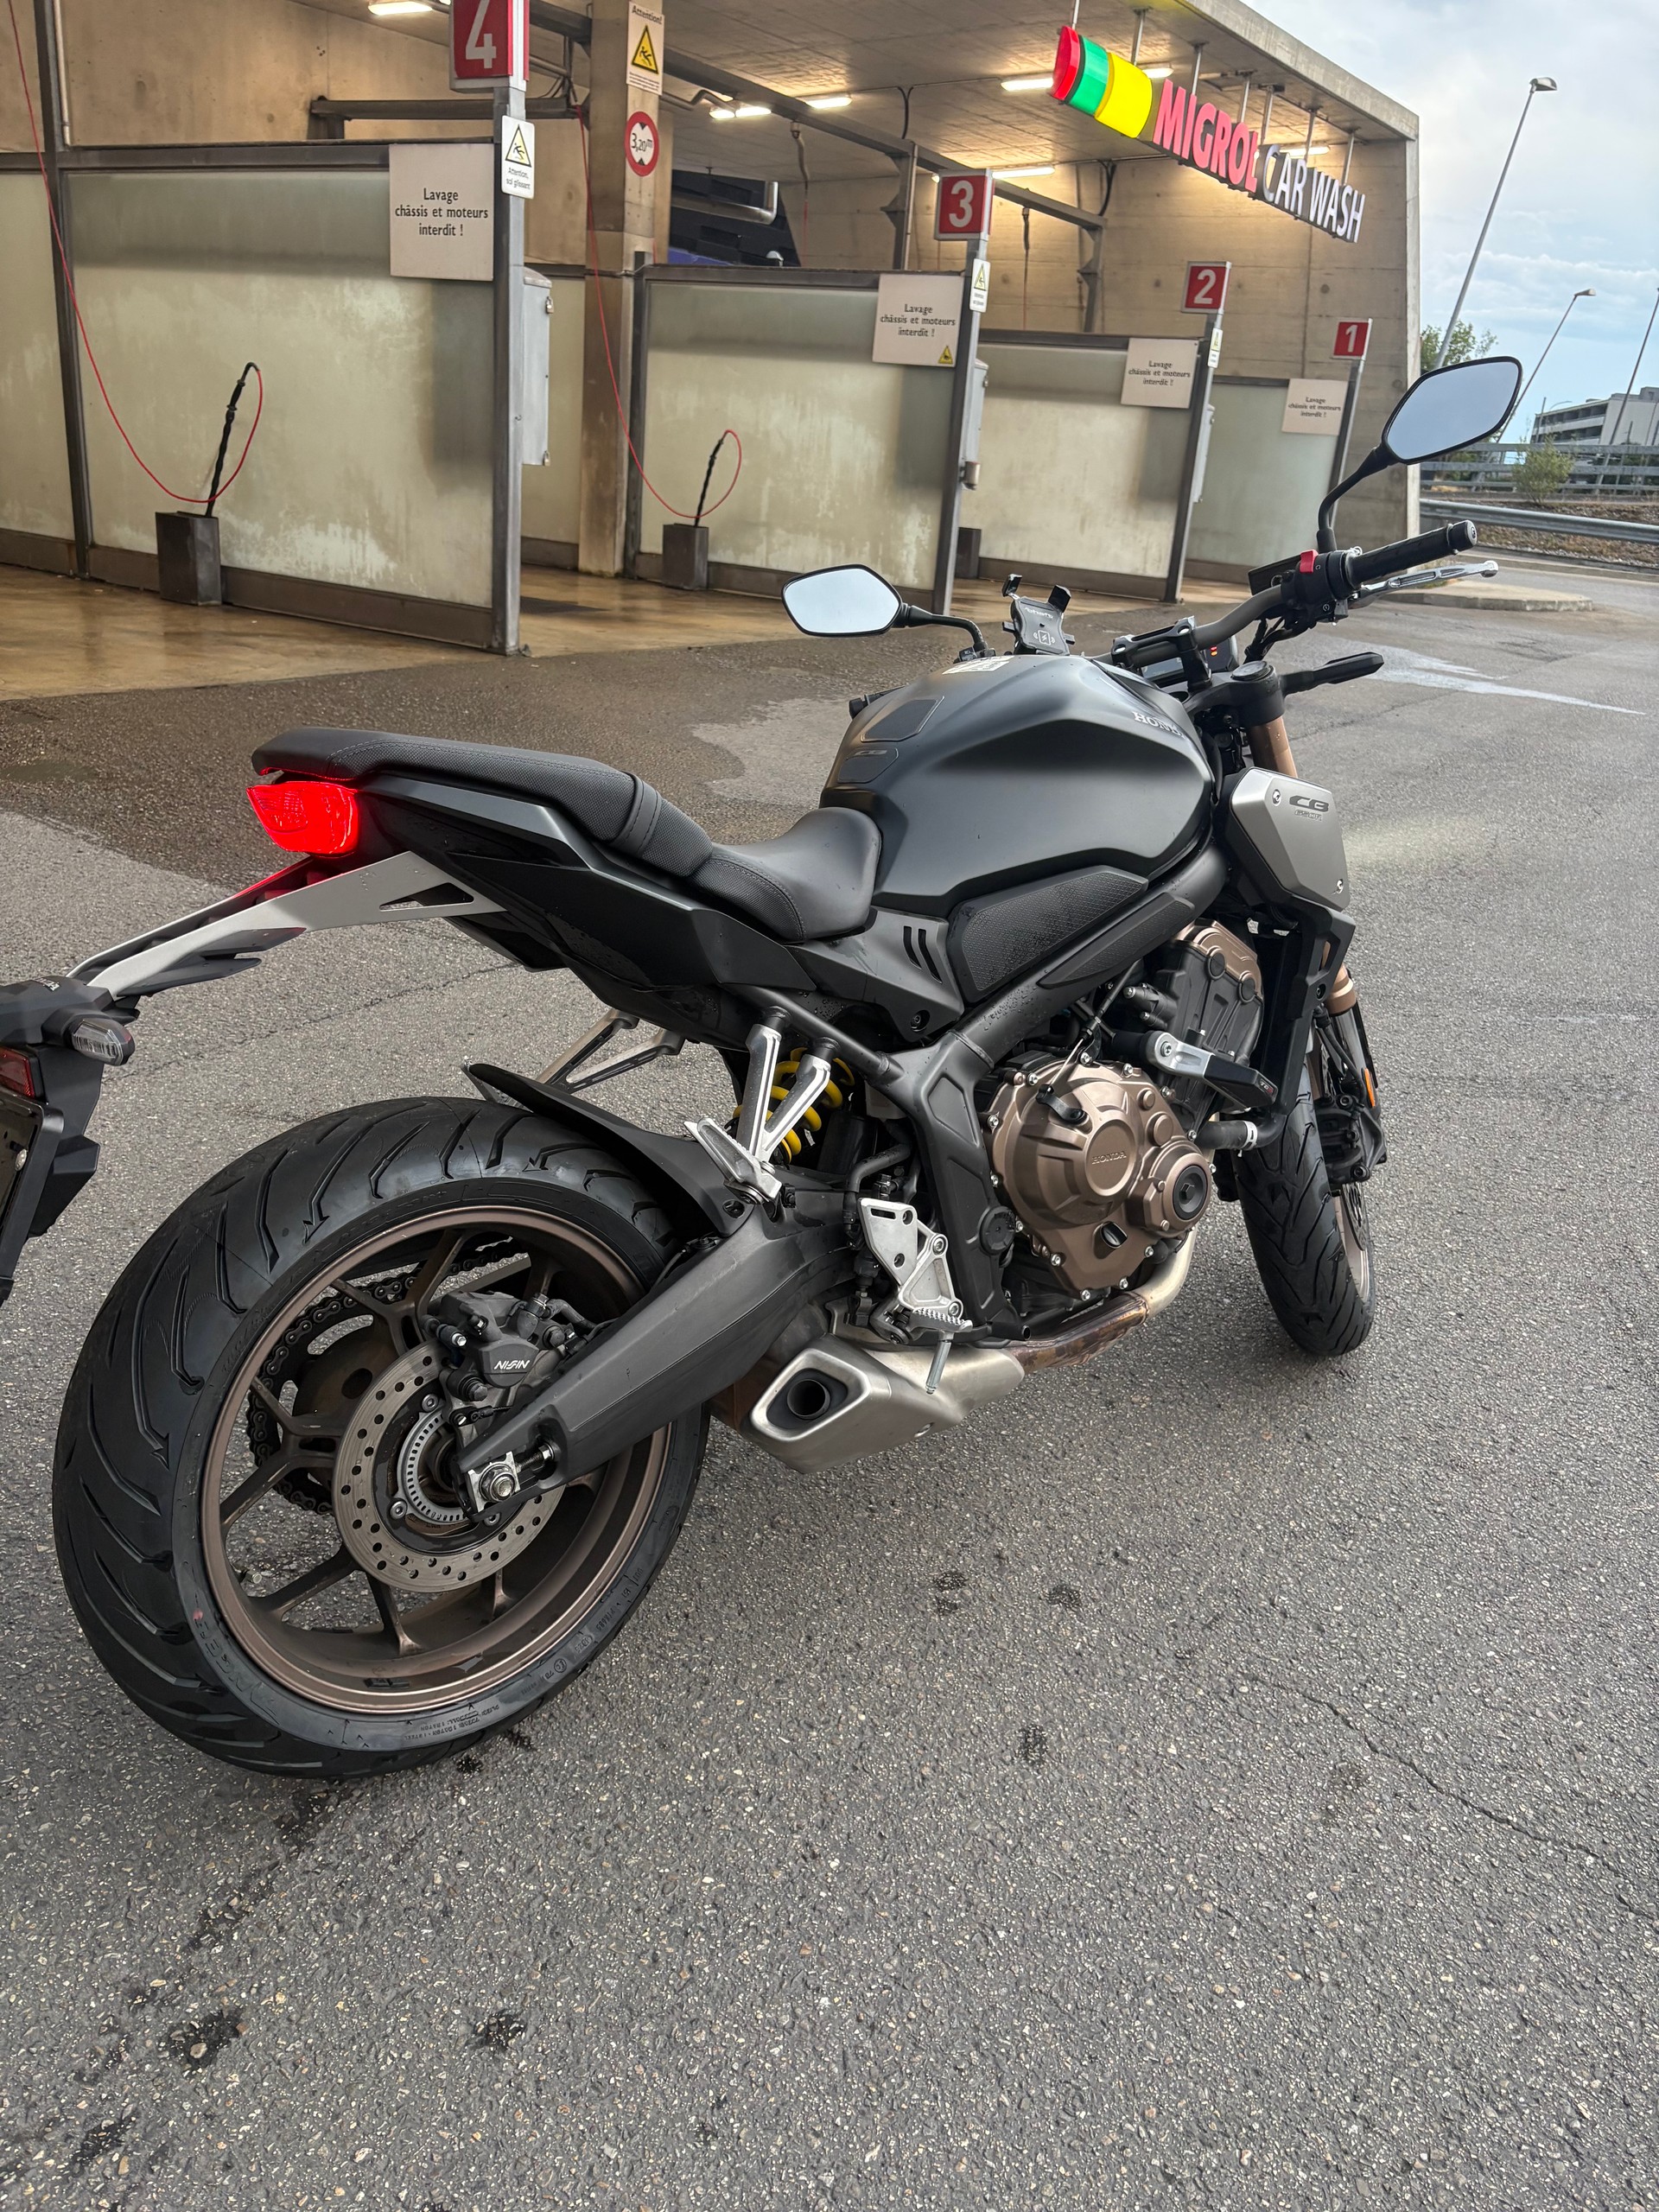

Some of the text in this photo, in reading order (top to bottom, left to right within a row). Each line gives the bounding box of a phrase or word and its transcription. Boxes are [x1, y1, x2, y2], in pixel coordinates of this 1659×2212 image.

[465, 0, 497, 69] 4
[1153, 79, 1365, 244] MIGROL CAR WASH
[423, 188, 459, 205] Lavage
[949, 180, 974, 227] 3
[395, 204, 488, 219] châssis et moteurs
[419, 222, 463, 236] interdit !
[1193, 270, 1217, 304] 2
[904, 304, 933, 315] Lavage
[921, 317, 956, 326] moteurs
[899, 327, 935, 337] interdit !
[1345, 324, 1358, 353] 1
[1289, 795, 1329, 812] CB
[1091, 1150, 1127, 1164] HONDA
